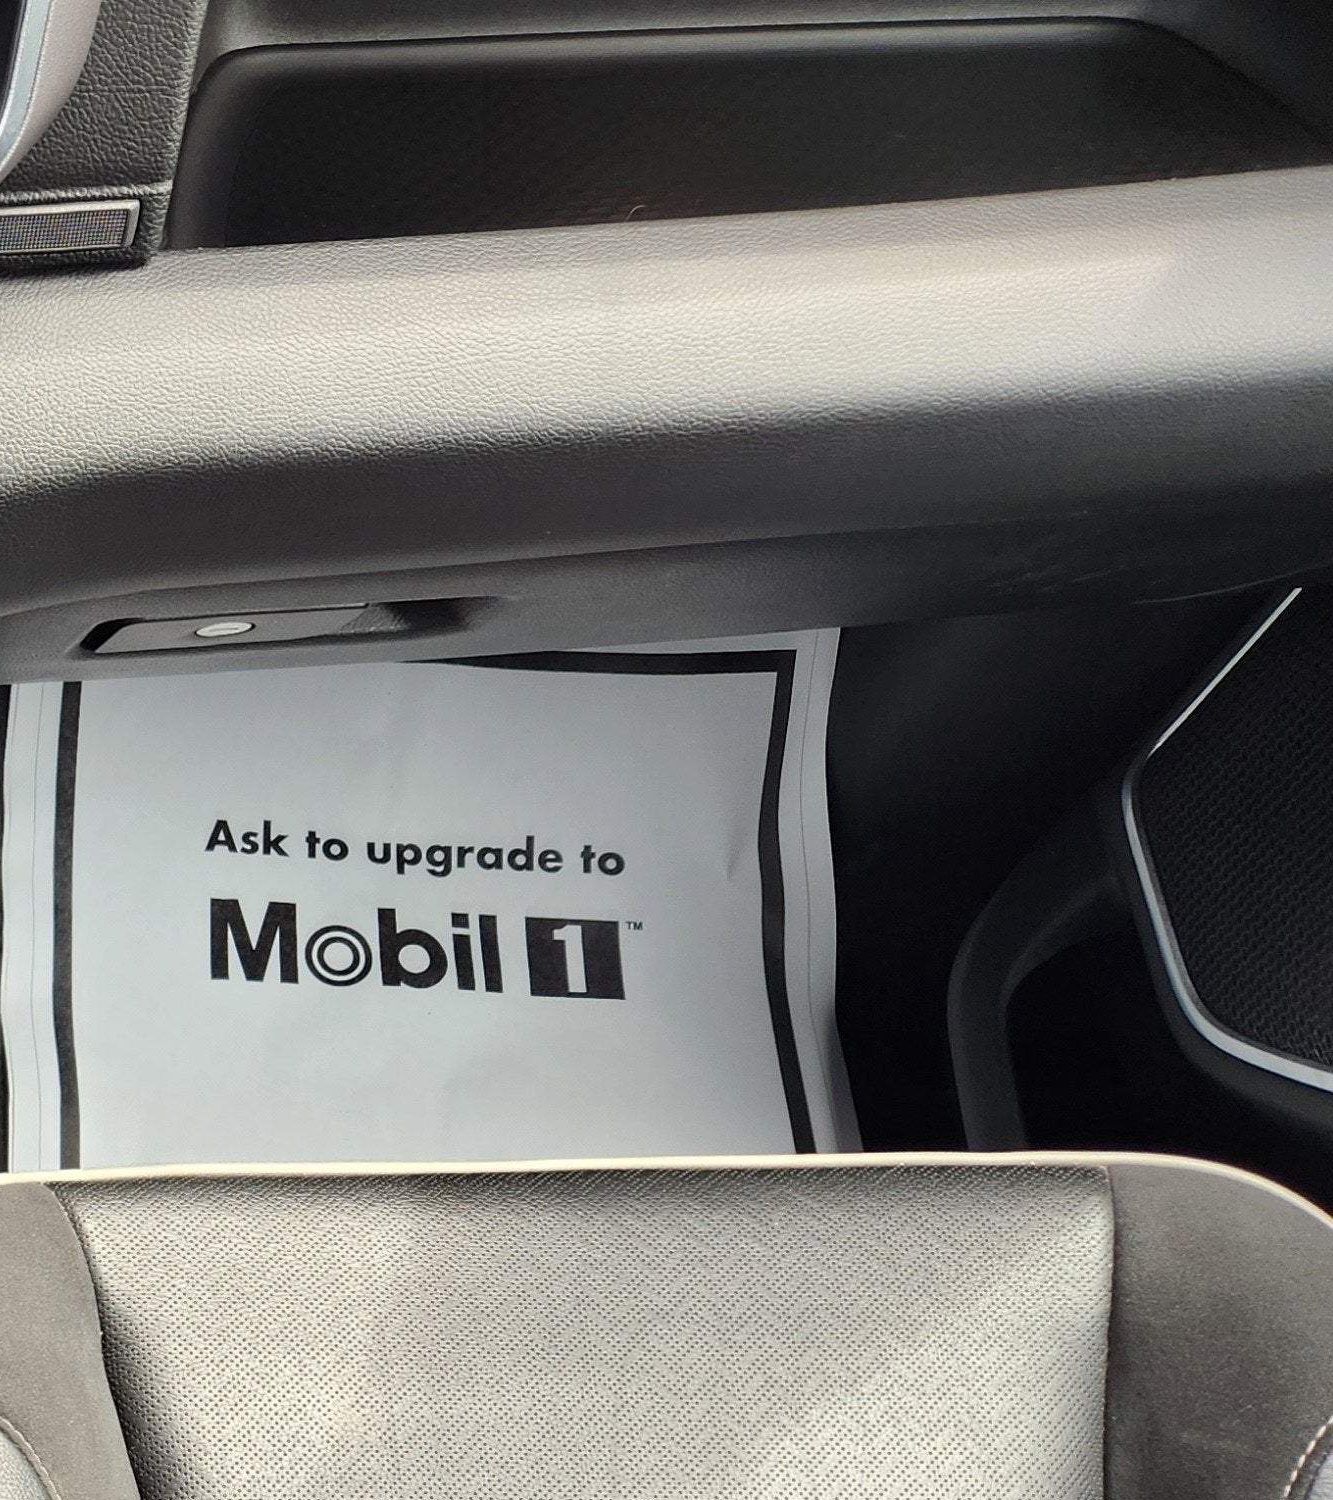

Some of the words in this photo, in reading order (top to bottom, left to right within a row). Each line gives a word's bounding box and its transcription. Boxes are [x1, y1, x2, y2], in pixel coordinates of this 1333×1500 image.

[205, 819, 289, 857] Ask
[305, 830, 349, 861] to
[367, 835, 563, 878] upgrade
[581, 844, 625, 876] to
[210, 898, 503, 993] Mobil
